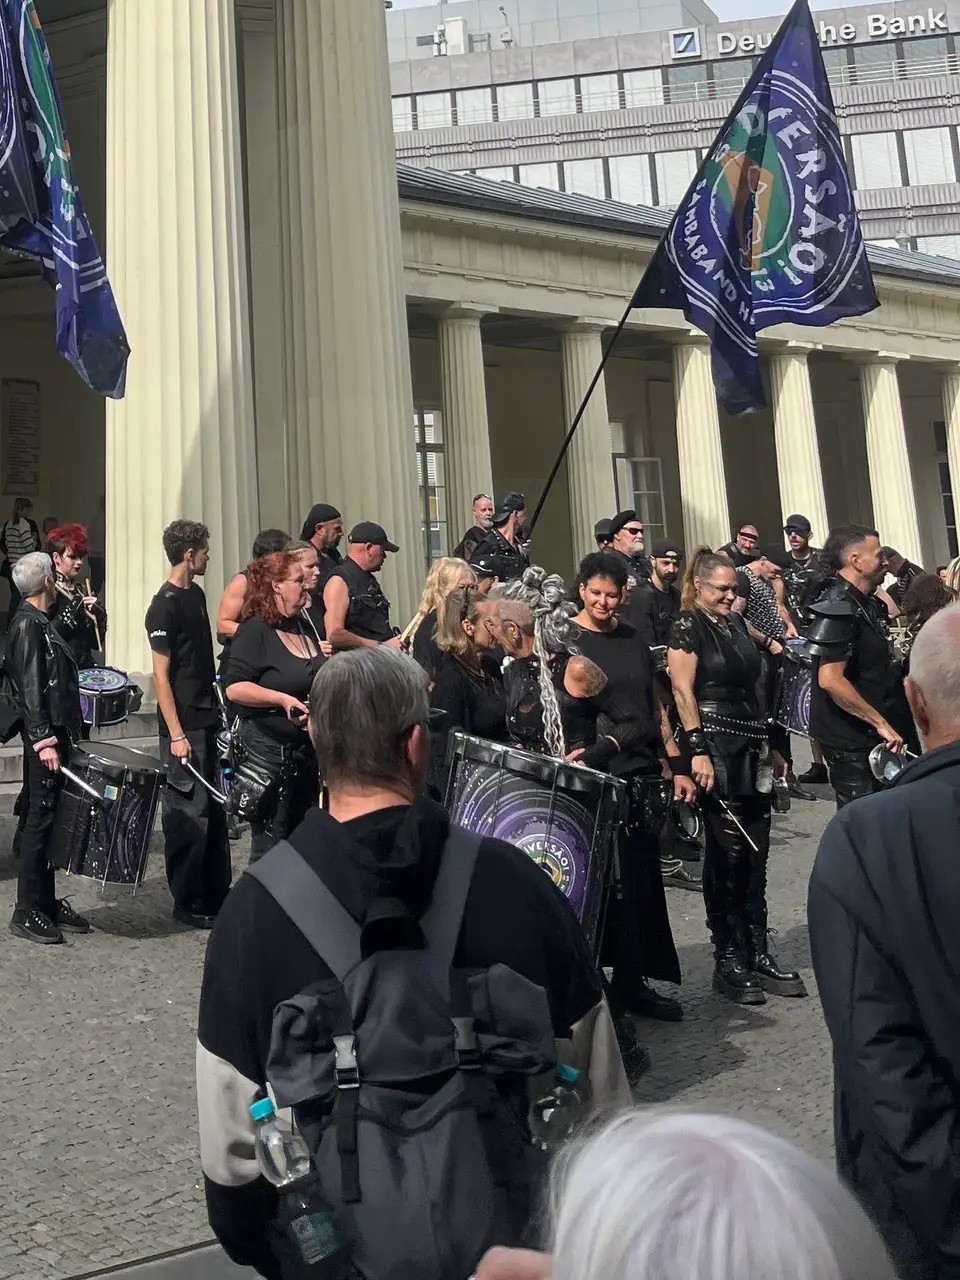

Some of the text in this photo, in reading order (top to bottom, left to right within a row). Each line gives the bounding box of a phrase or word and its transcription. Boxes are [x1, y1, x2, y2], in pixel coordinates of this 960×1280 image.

[717, 8, 948, 55] Deuhe Bank
[683, 178, 738, 303] SAMBABAND
